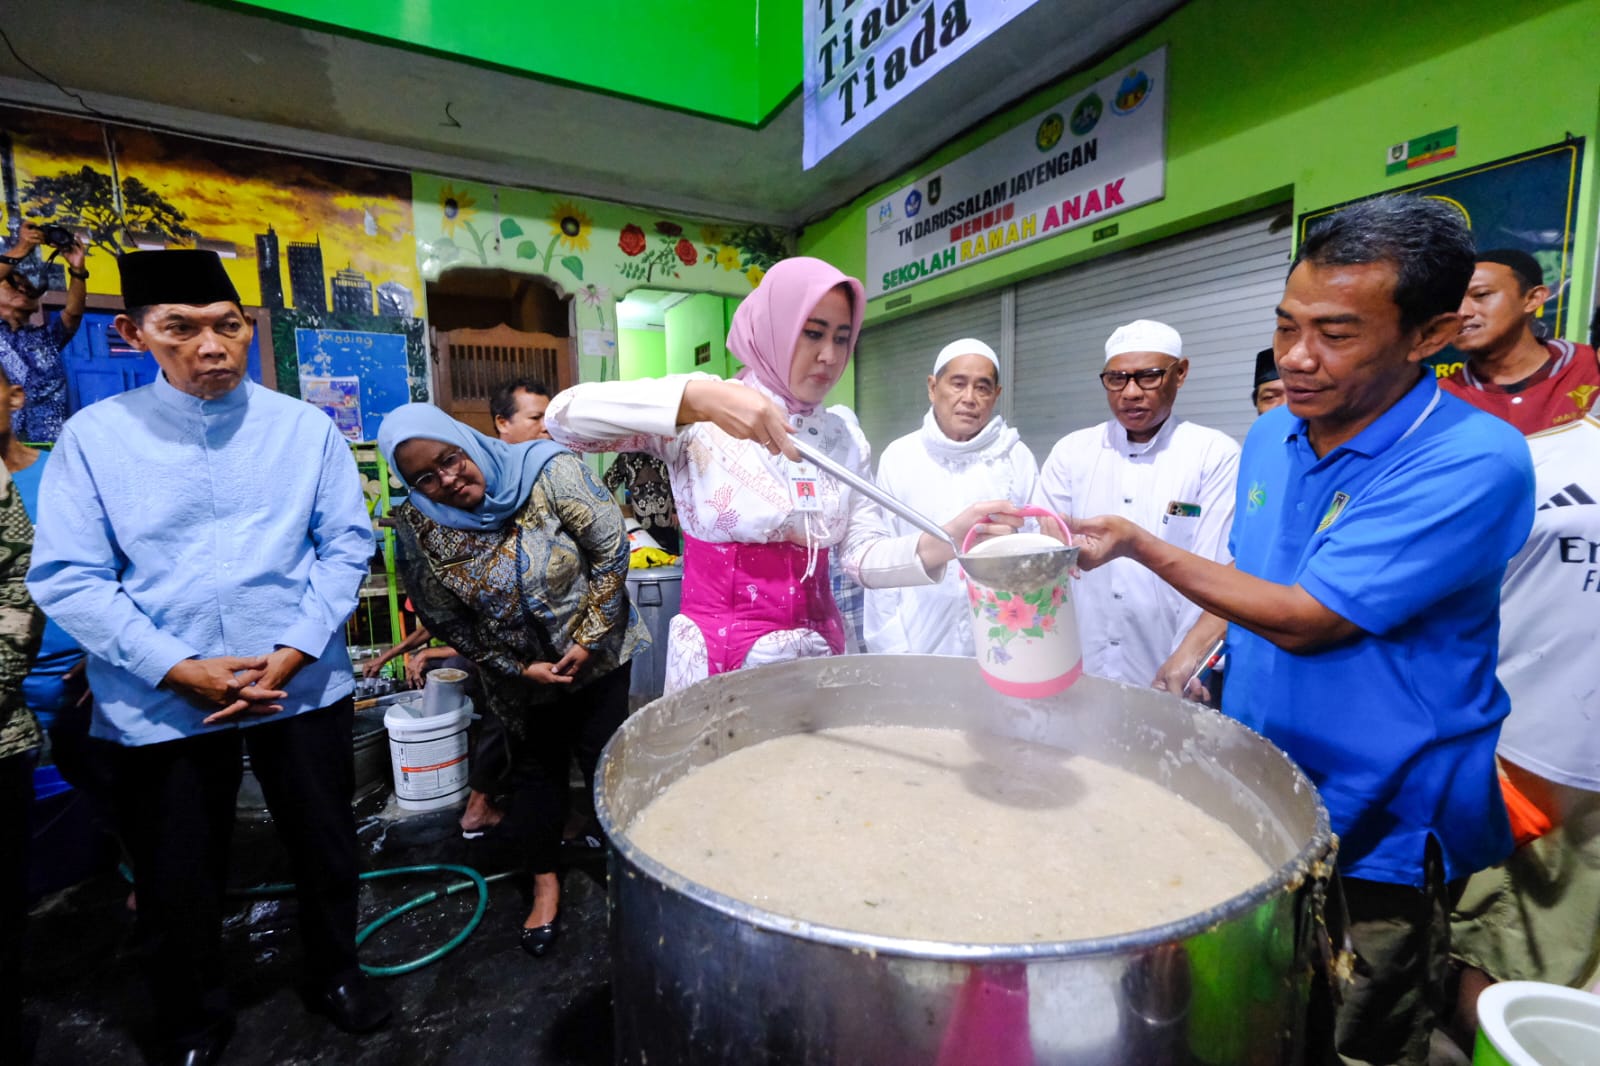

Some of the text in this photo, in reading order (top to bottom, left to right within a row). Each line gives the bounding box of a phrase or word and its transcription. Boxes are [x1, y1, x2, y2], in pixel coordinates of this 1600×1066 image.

[839, 0, 971, 125] Tiada
[882, 246, 956, 290] SEKOLAH
[960, 214, 1036, 262] RAMAH
[1042, 177, 1125, 232] ANAK
[898, 138, 1098, 247] TK DARUSSALAM JAYENGAN
[950, 202, 1014, 242] MENUJU
